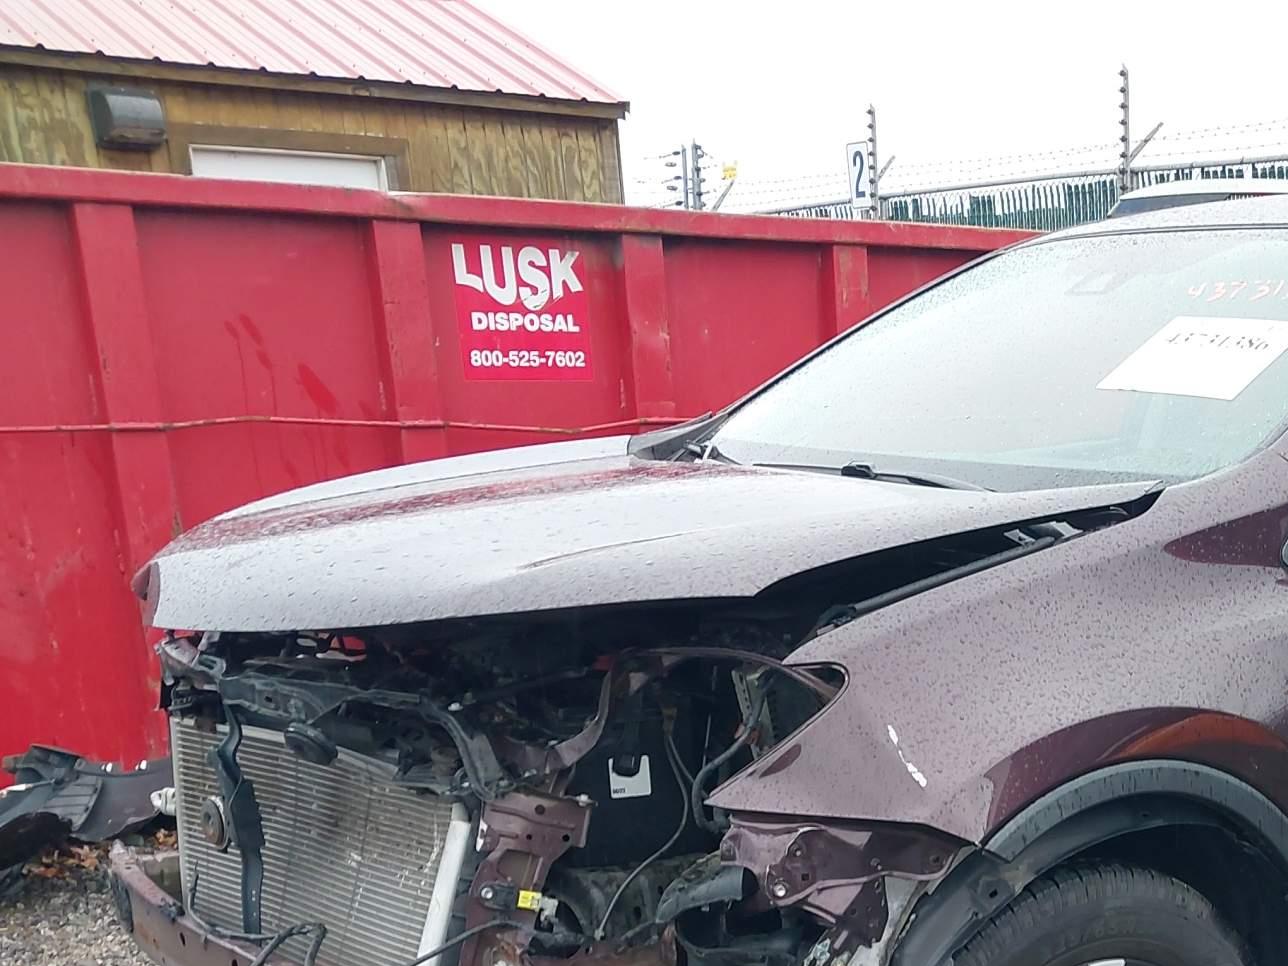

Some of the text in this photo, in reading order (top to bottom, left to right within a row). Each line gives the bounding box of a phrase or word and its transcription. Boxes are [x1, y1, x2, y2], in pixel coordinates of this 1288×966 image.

[853, 151, 866, 198] 2
[451, 243, 584, 311] LUSK
[471, 312, 580, 333] DISPOSAL
[470, 350, 586, 368] 800-525-7602
